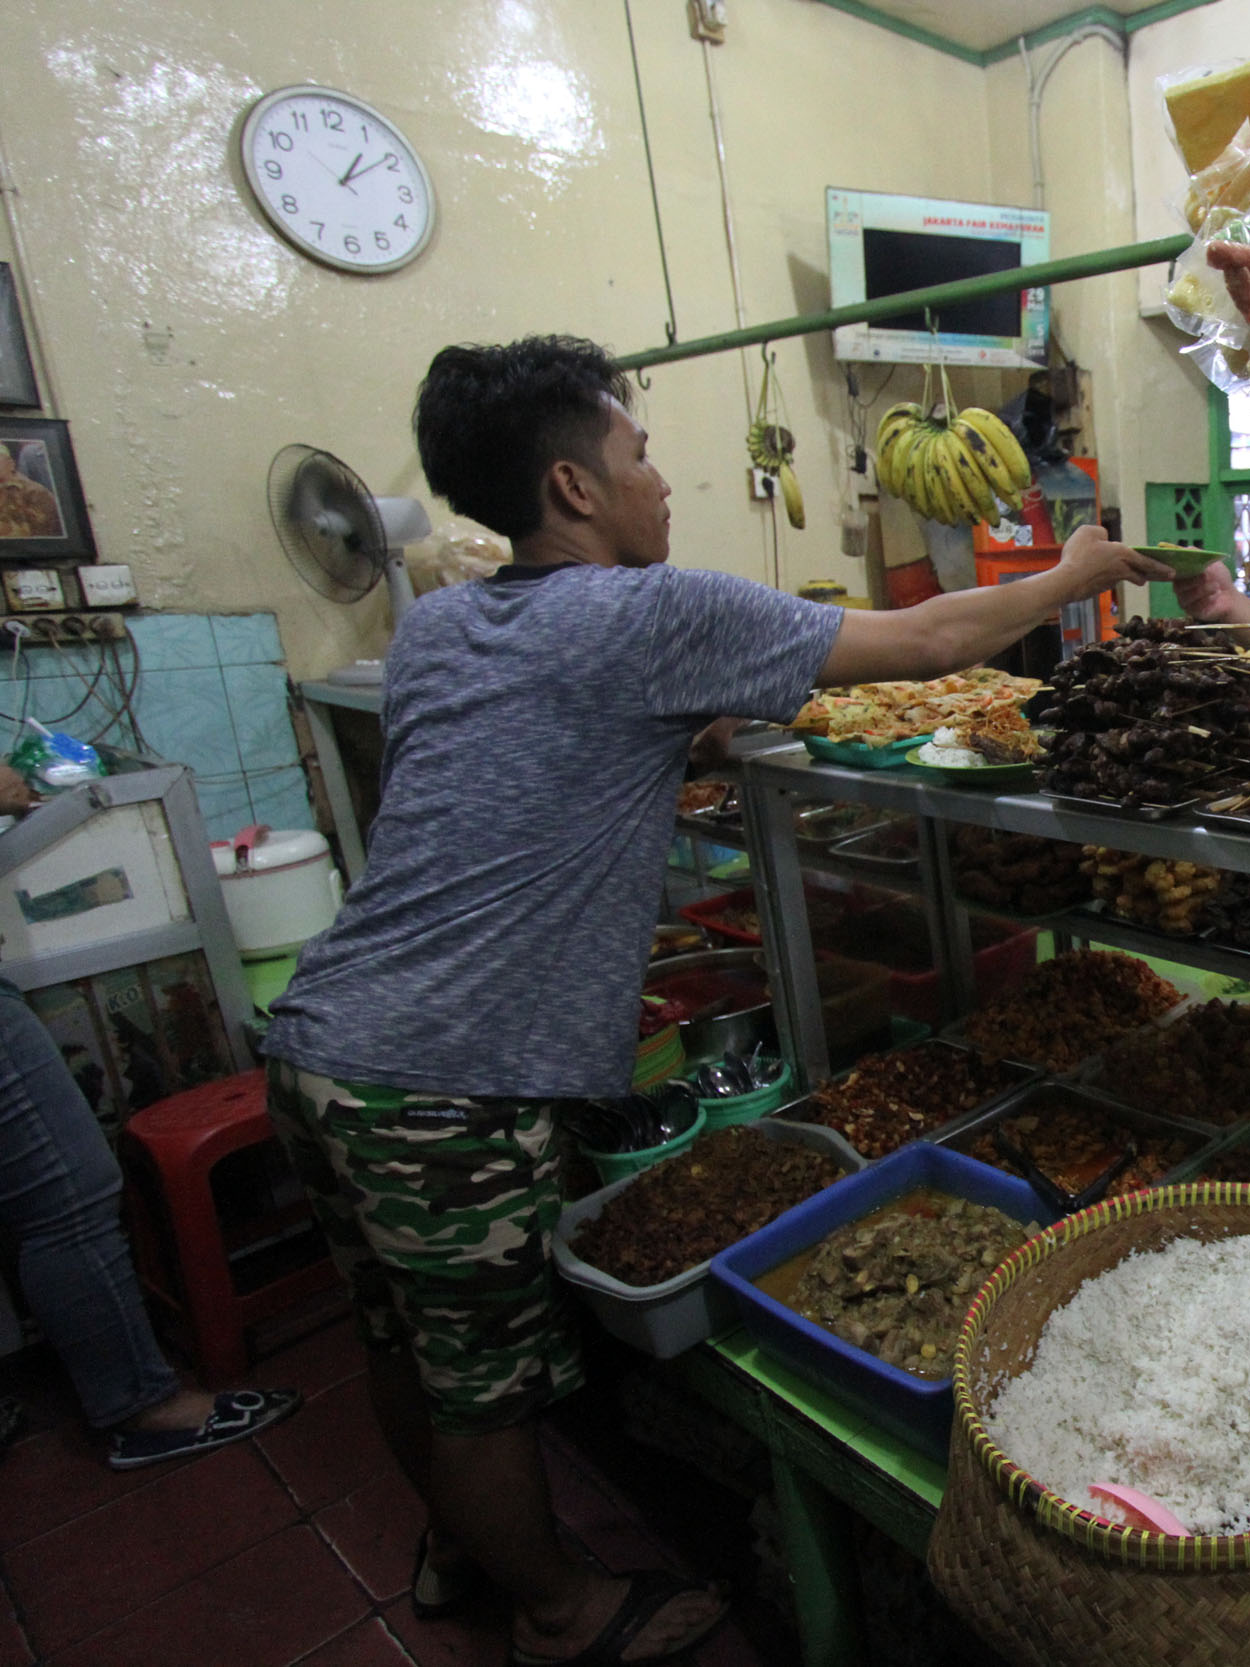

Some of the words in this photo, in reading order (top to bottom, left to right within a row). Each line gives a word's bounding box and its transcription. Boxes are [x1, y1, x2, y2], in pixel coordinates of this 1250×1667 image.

[291, 110, 309, 132] 11
[320, 108, 345, 132] 12
[268, 130, 294, 152] 10
[361, 124, 369, 144] 1
[264, 160, 283, 180] 9
[384, 152, 400, 172] 2
[281, 194, 299, 214] 8
[397, 185, 414, 204] 3
[309, 220, 326, 240] 7
[393, 213, 408, 231] 4
[344, 235, 361, 254] 6
[374, 231, 390, 251] 5
